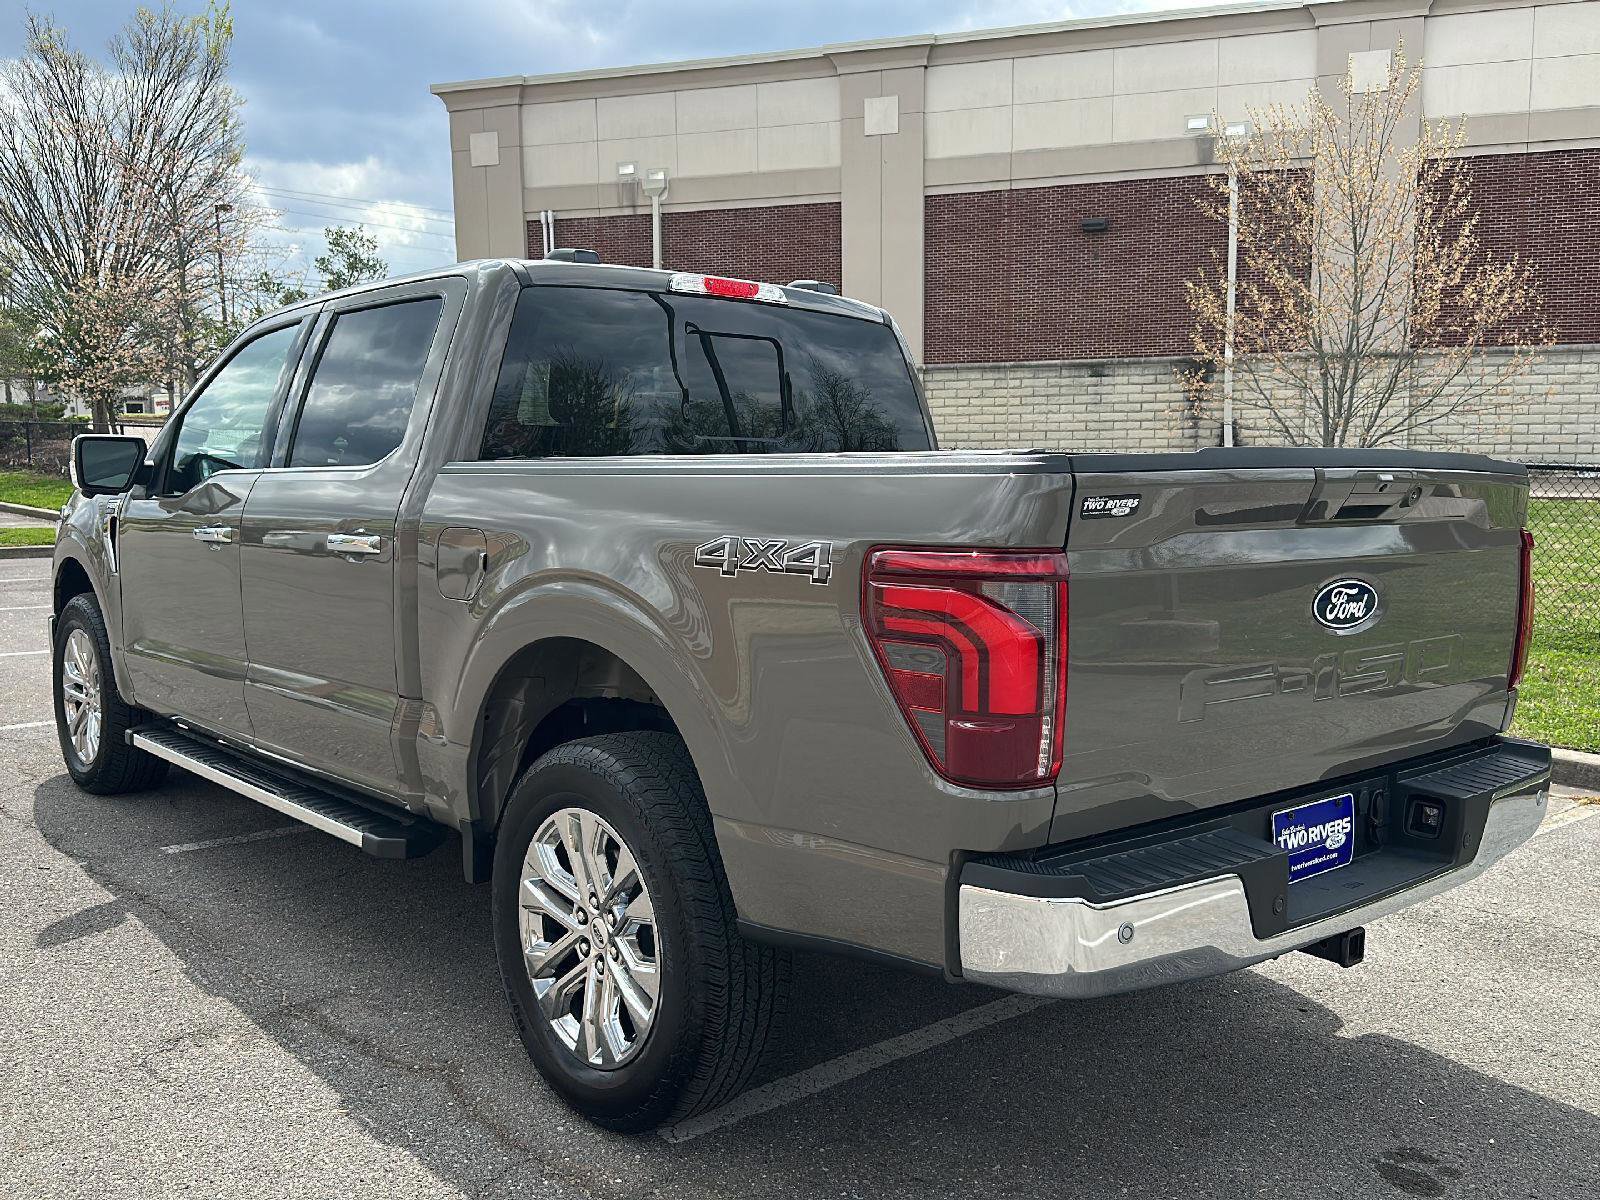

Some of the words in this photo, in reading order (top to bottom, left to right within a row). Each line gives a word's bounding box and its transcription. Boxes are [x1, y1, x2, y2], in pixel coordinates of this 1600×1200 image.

[1083, 501, 1105, 510] TWO
[1105, 498, 1140, 509] RIVERS
[1326, 587, 1368, 620] Ford
[1178, 633, 1464, 724] F-150
[1278, 829, 1308, 849] TWO
[1308, 816, 1351, 844] RIVERS
